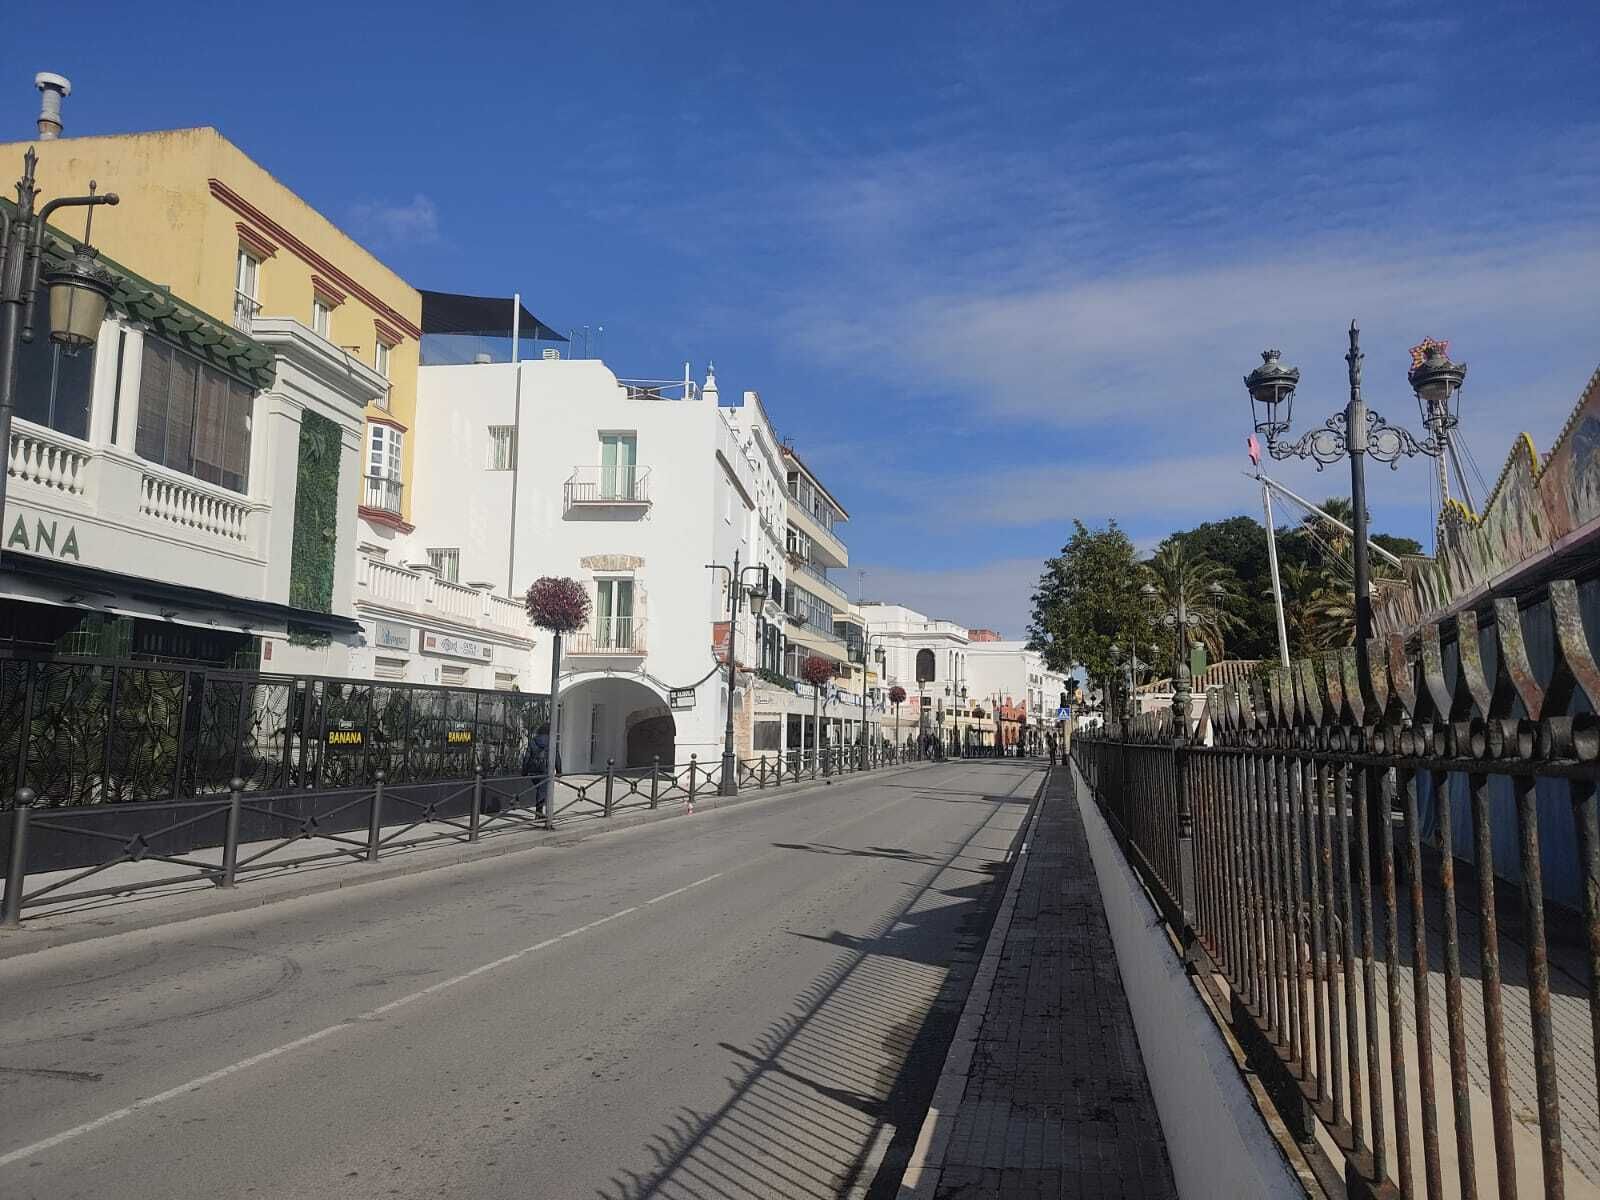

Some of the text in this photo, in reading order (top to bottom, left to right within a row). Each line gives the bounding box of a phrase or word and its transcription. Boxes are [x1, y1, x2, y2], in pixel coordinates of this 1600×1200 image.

[8, 513, 80, 560] ANA
[328, 731, 362, 744] BANANA
[447, 731, 471, 743] BANANA
